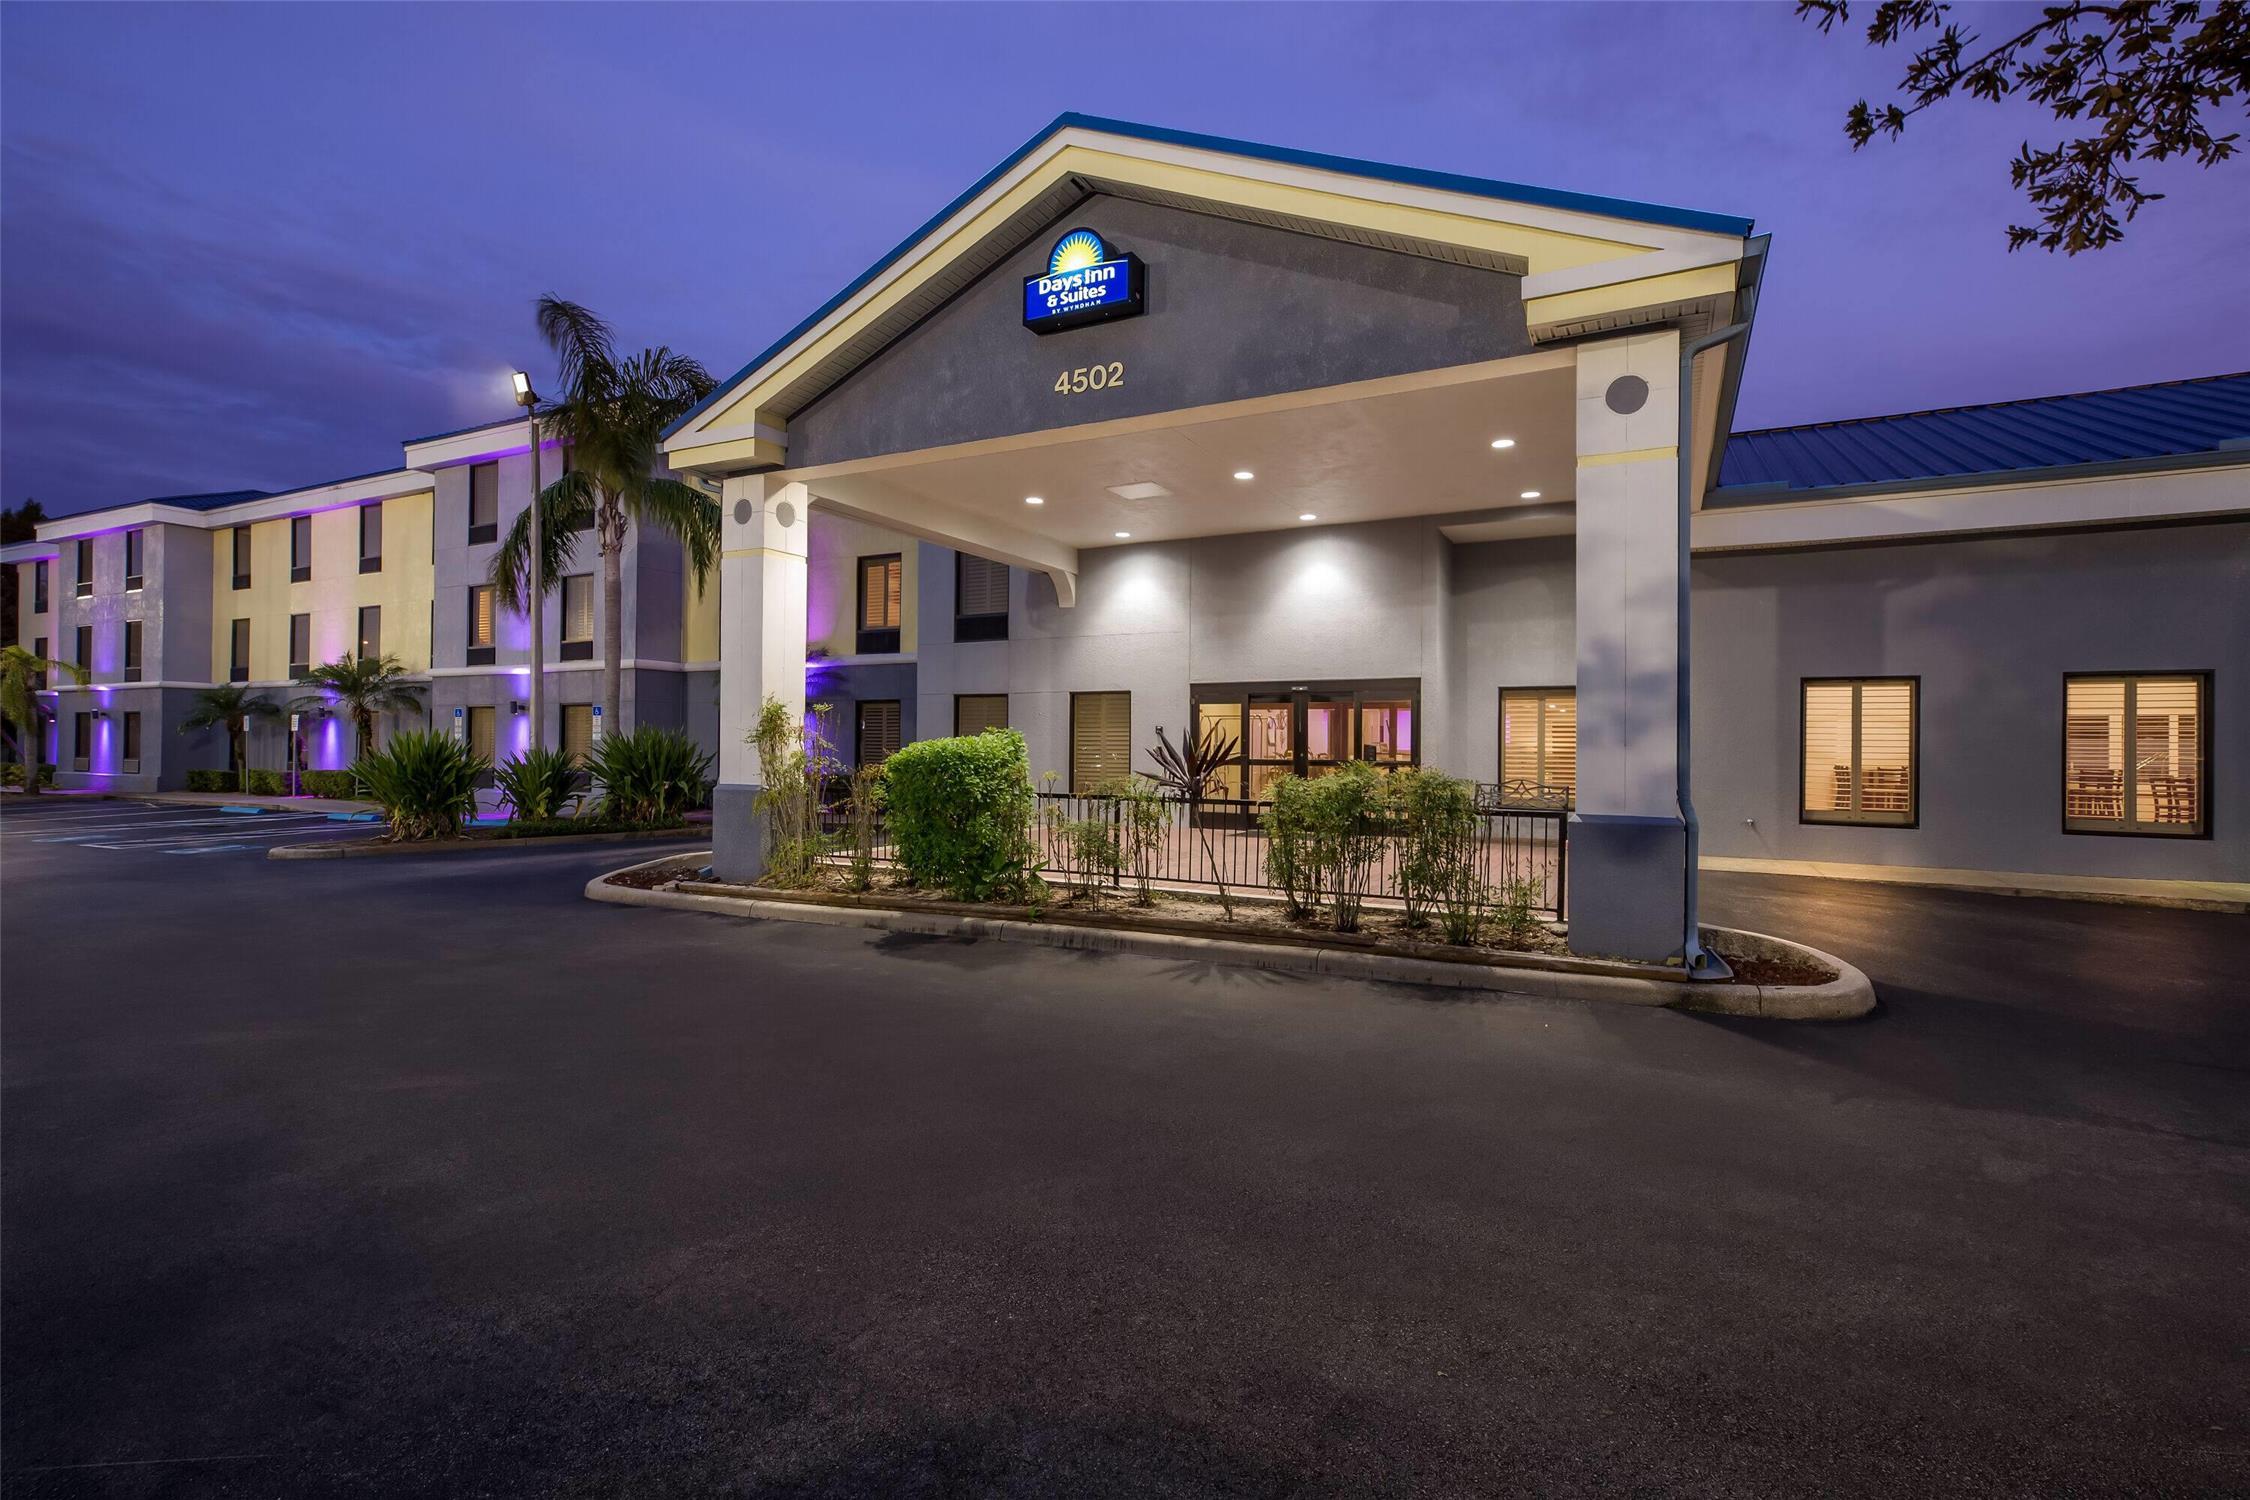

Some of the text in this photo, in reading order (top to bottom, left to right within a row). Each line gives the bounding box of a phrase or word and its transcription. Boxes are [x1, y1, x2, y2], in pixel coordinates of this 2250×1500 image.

[1039, 266, 1116, 295] Days Inn
[1046, 285, 1107, 308] & Suites
[1063, 299, 1101, 312] WYNDHAM
[1054, 361, 1124, 395] 4502
